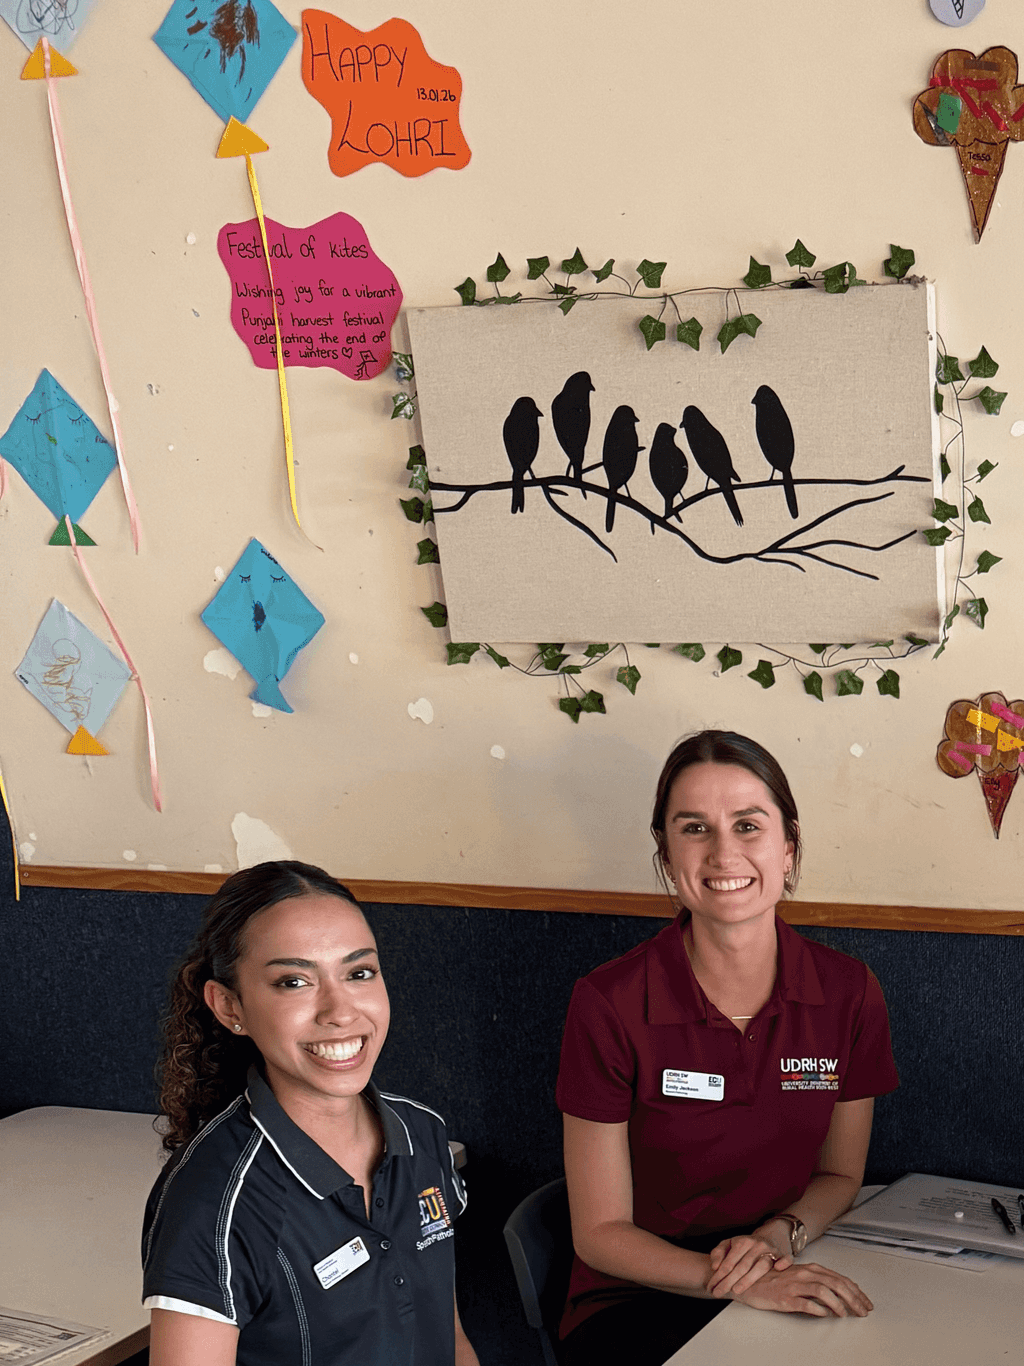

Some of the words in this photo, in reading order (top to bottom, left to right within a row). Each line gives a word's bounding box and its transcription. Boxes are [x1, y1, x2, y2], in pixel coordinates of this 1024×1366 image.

[306, 23, 407, 88] HAPPY
[416, 87, 456, 103] 13.01.26
[337, 100, 457, 157] LOHRI
[968, 151, 992, 161] Tessa
[226, 232, 293, 260] Festval
[299, 234, 316, 260] of
[328, 237, 369, 259] kites
[235, 282, 285, 305] Wishing
[291, 280, 313, 303] joy
[318, 279, 334, 297] for
[342, 287, 351, 297] a
[355, 283, 397, 298] vibrant
[291, 312, 334, 326] harvest
[343, 310, 385, 327] festival
[254, 332, 314, 350] celerating
[318, 331, 339, 344] the
[346, 331, 366, 344] end
[372, 331, 387, 344] of
[269, 347, 290, 359] te
[298, 347, 339, 359] winters
[780, 1057, 818, 1073] UDRH
[819, 1058, 839, 1073] SW
